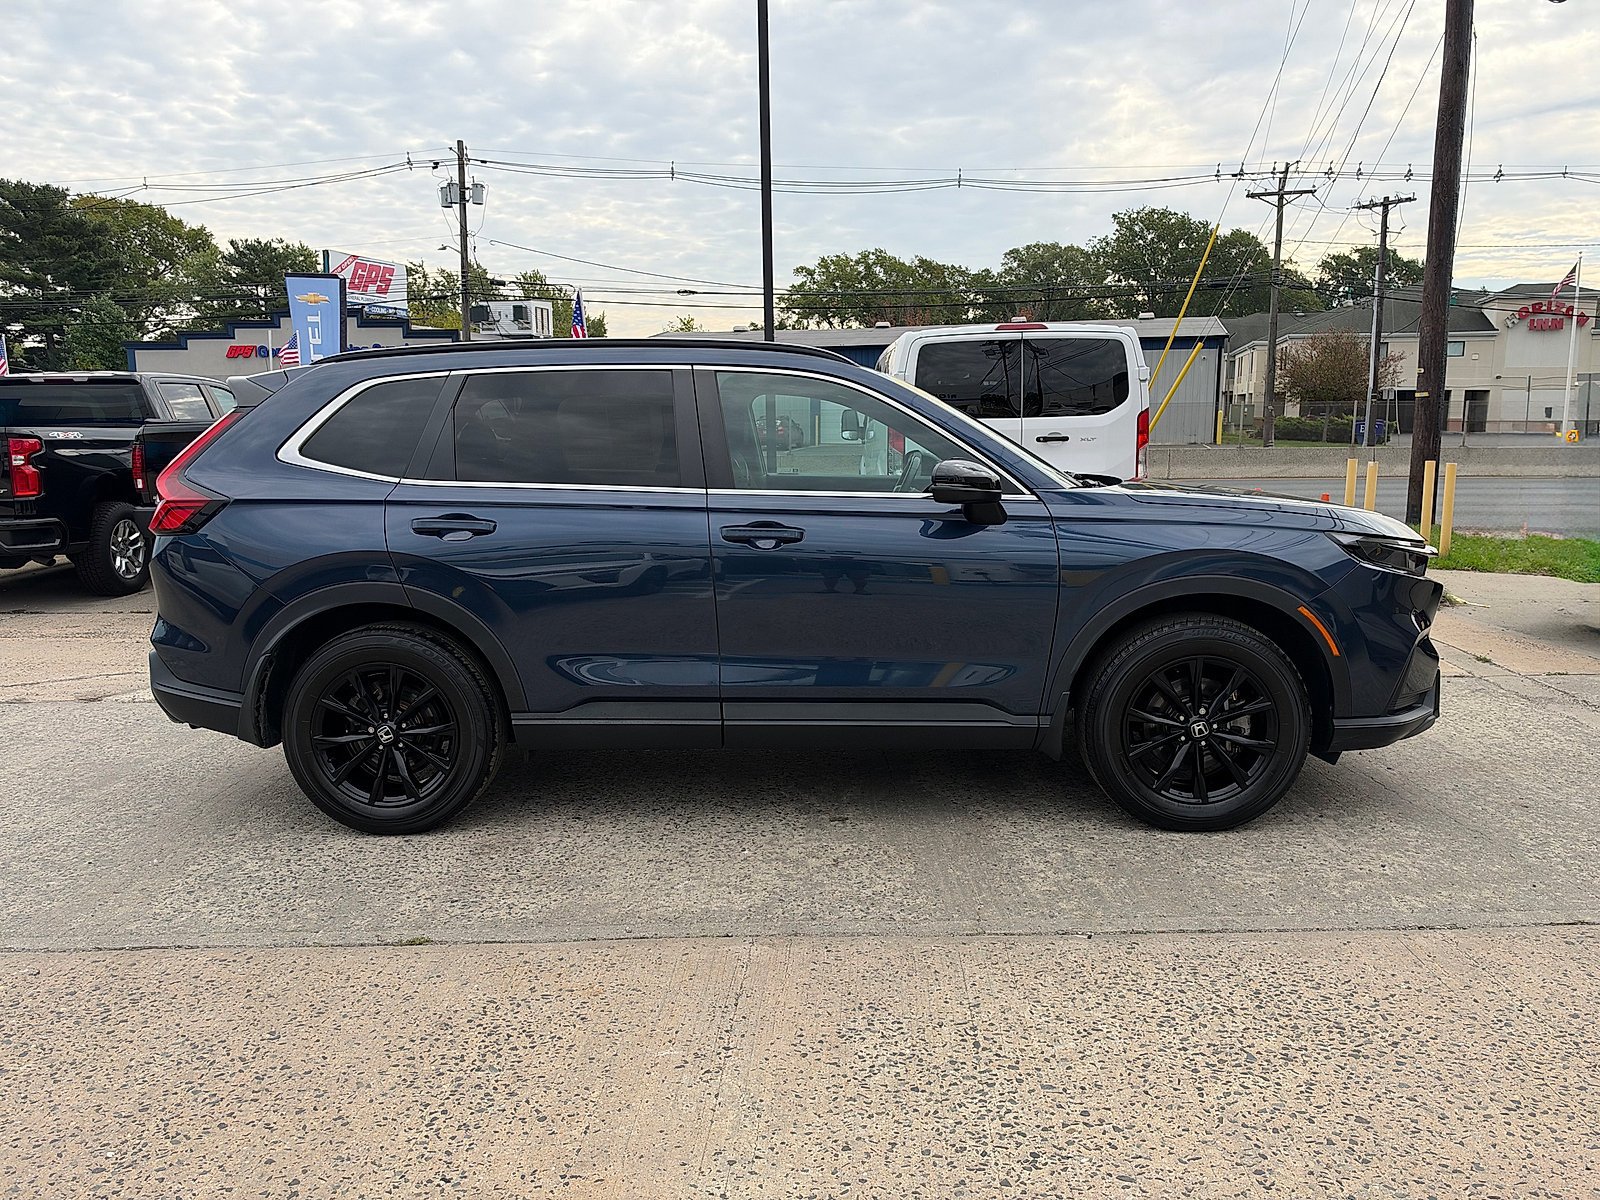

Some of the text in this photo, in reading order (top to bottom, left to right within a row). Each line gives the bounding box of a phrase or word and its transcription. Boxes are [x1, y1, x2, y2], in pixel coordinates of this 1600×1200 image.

[348, 262, 395, 295] GPS
[1504, 300, 1590, 328] HORIZON
[1528, 318, 1564, 331] INN
[226, 345, 254, 358] GPS
